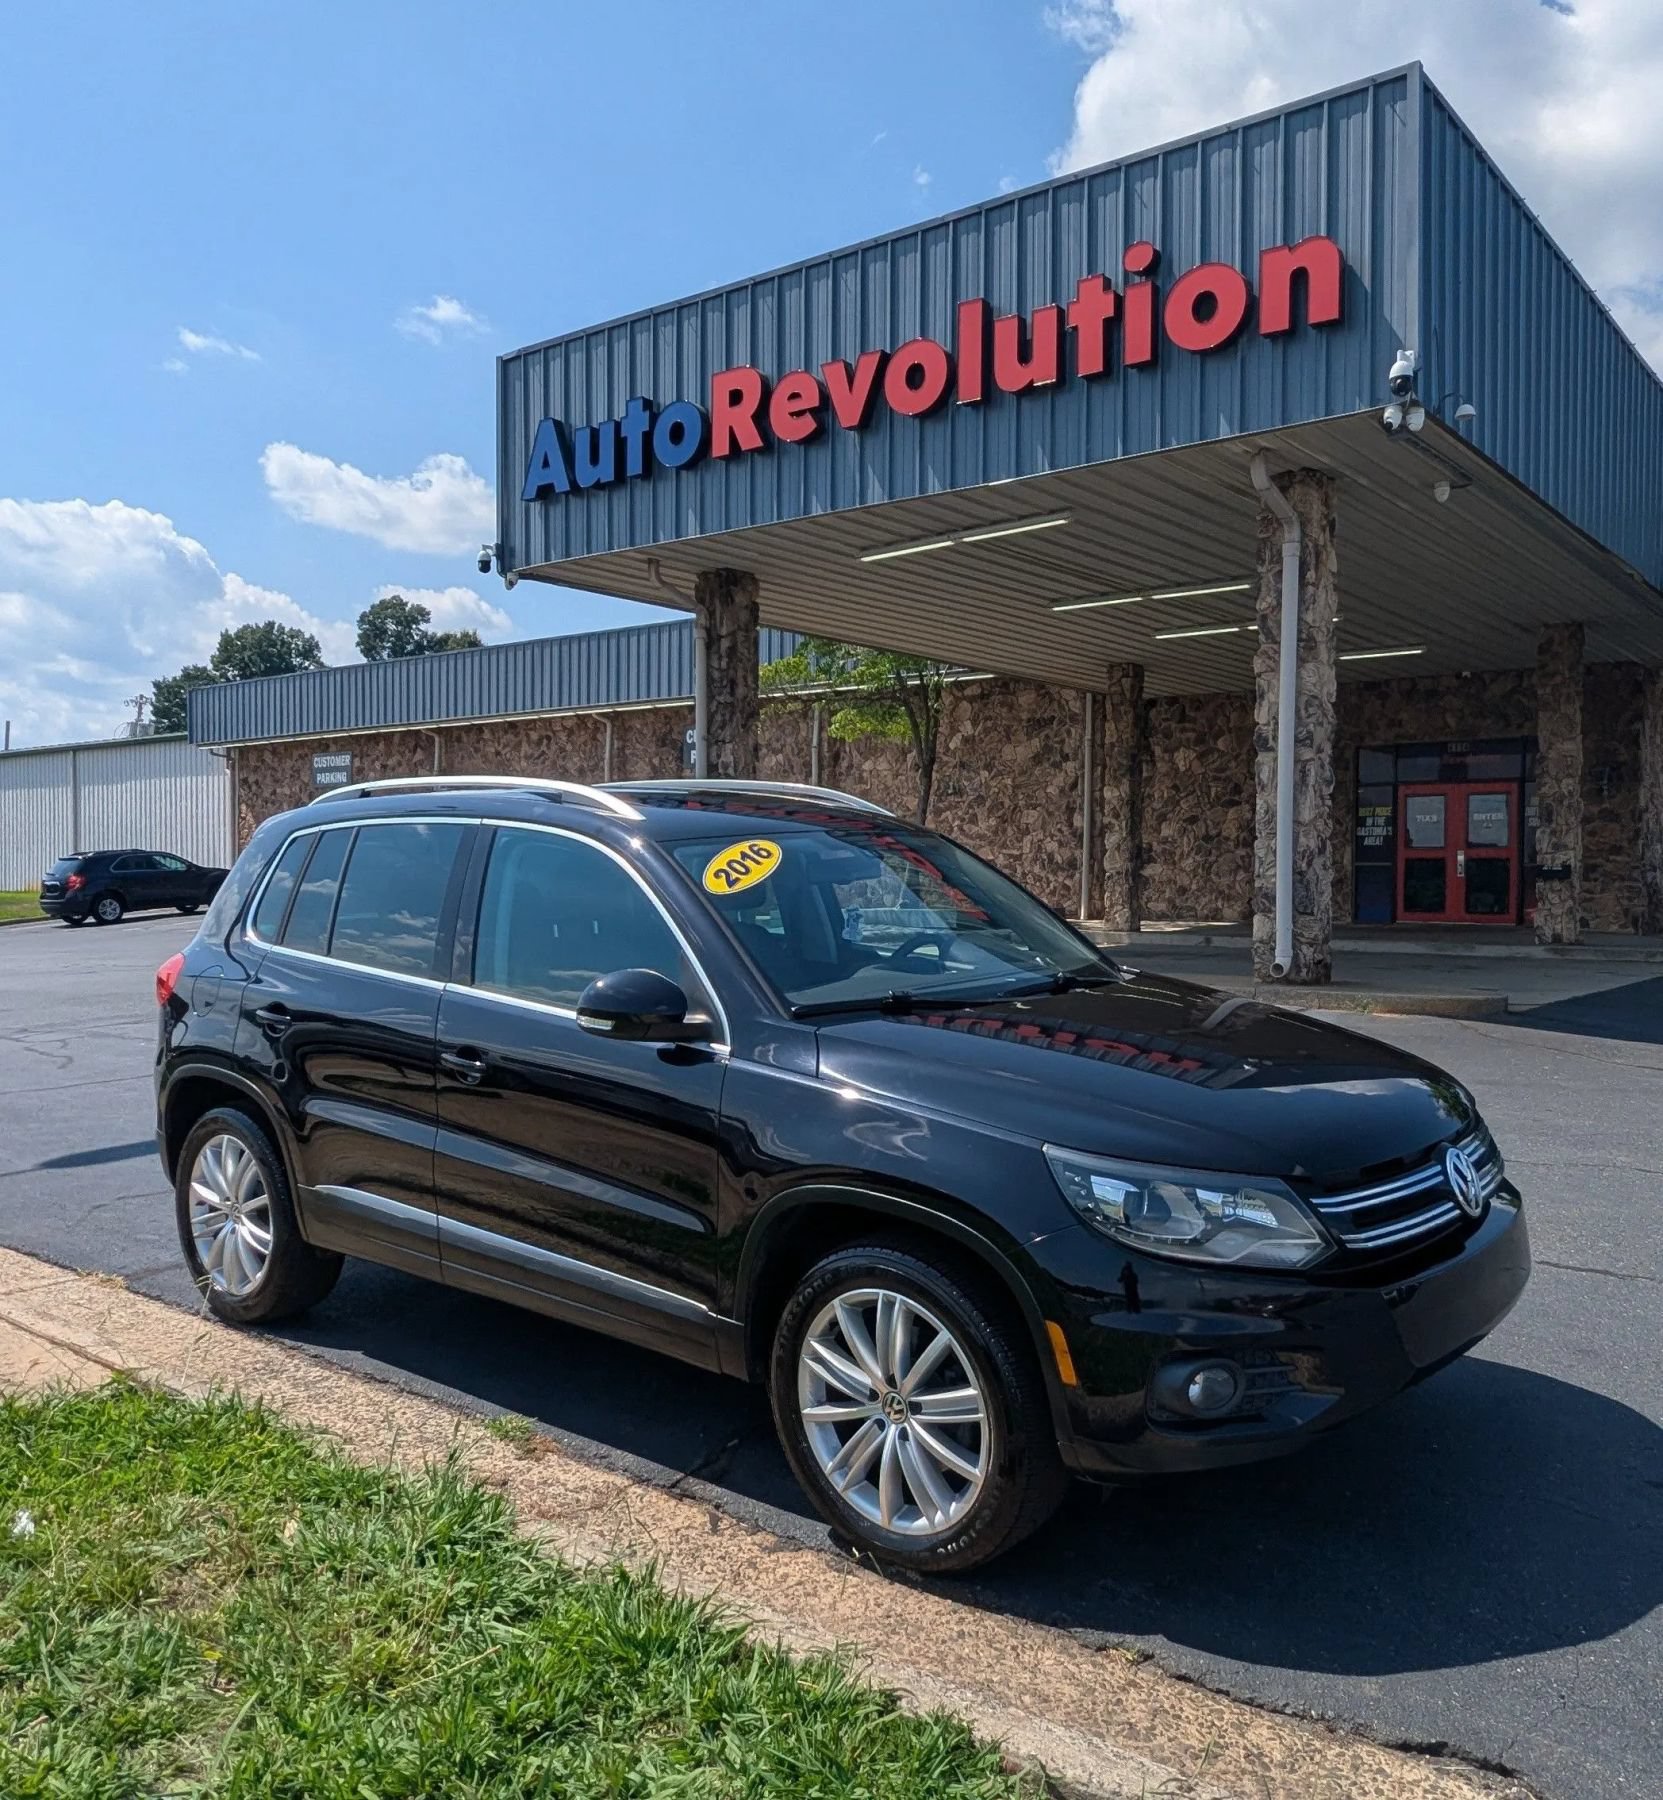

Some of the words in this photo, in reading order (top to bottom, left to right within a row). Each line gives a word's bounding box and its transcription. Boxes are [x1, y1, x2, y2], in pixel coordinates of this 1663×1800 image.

[521, 235, 1343, 502] AutoRevolution
[313, 755, 350, 768] CUSTOMER
[316, 771, 347, 784] PARKING
[713, 843, 773, 889] 2016
